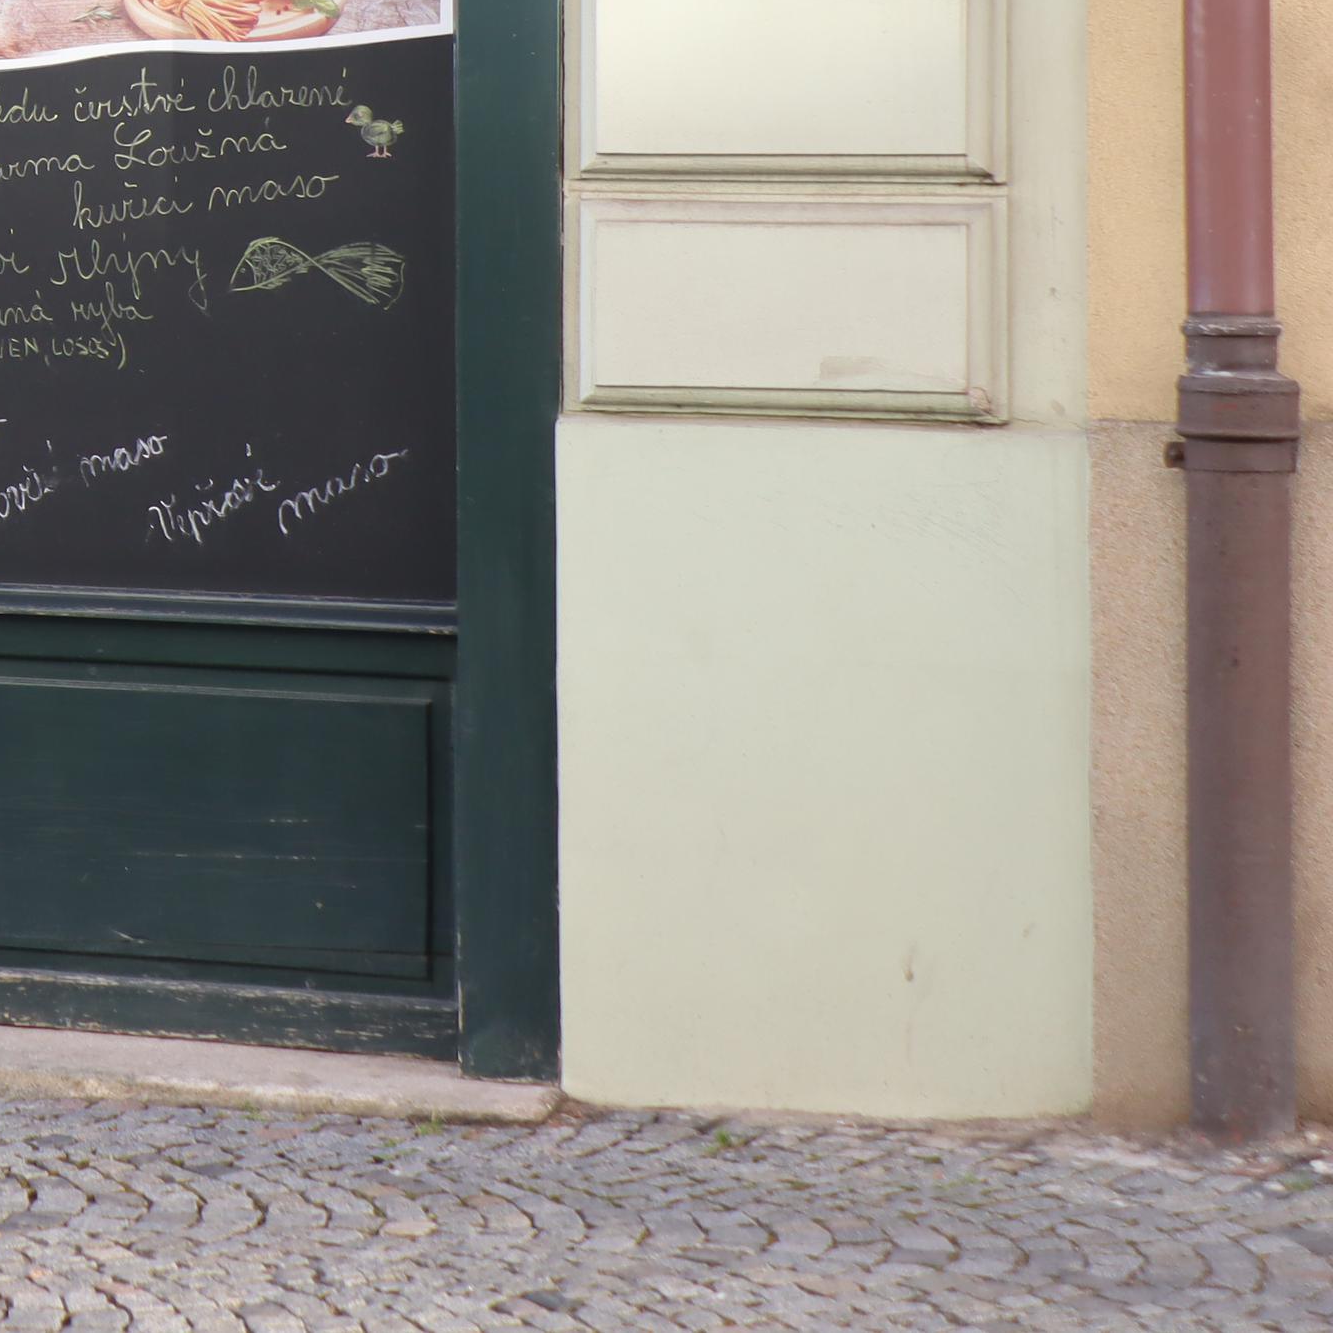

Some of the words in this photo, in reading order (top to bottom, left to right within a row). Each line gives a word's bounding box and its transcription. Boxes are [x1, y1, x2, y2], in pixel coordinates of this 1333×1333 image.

[74, 67, 196, 123] čerstvé
[208, 65, 353, 113] chlazené
[208, 174, 340, 212] maso
[79, 435, 167, 488] maso
